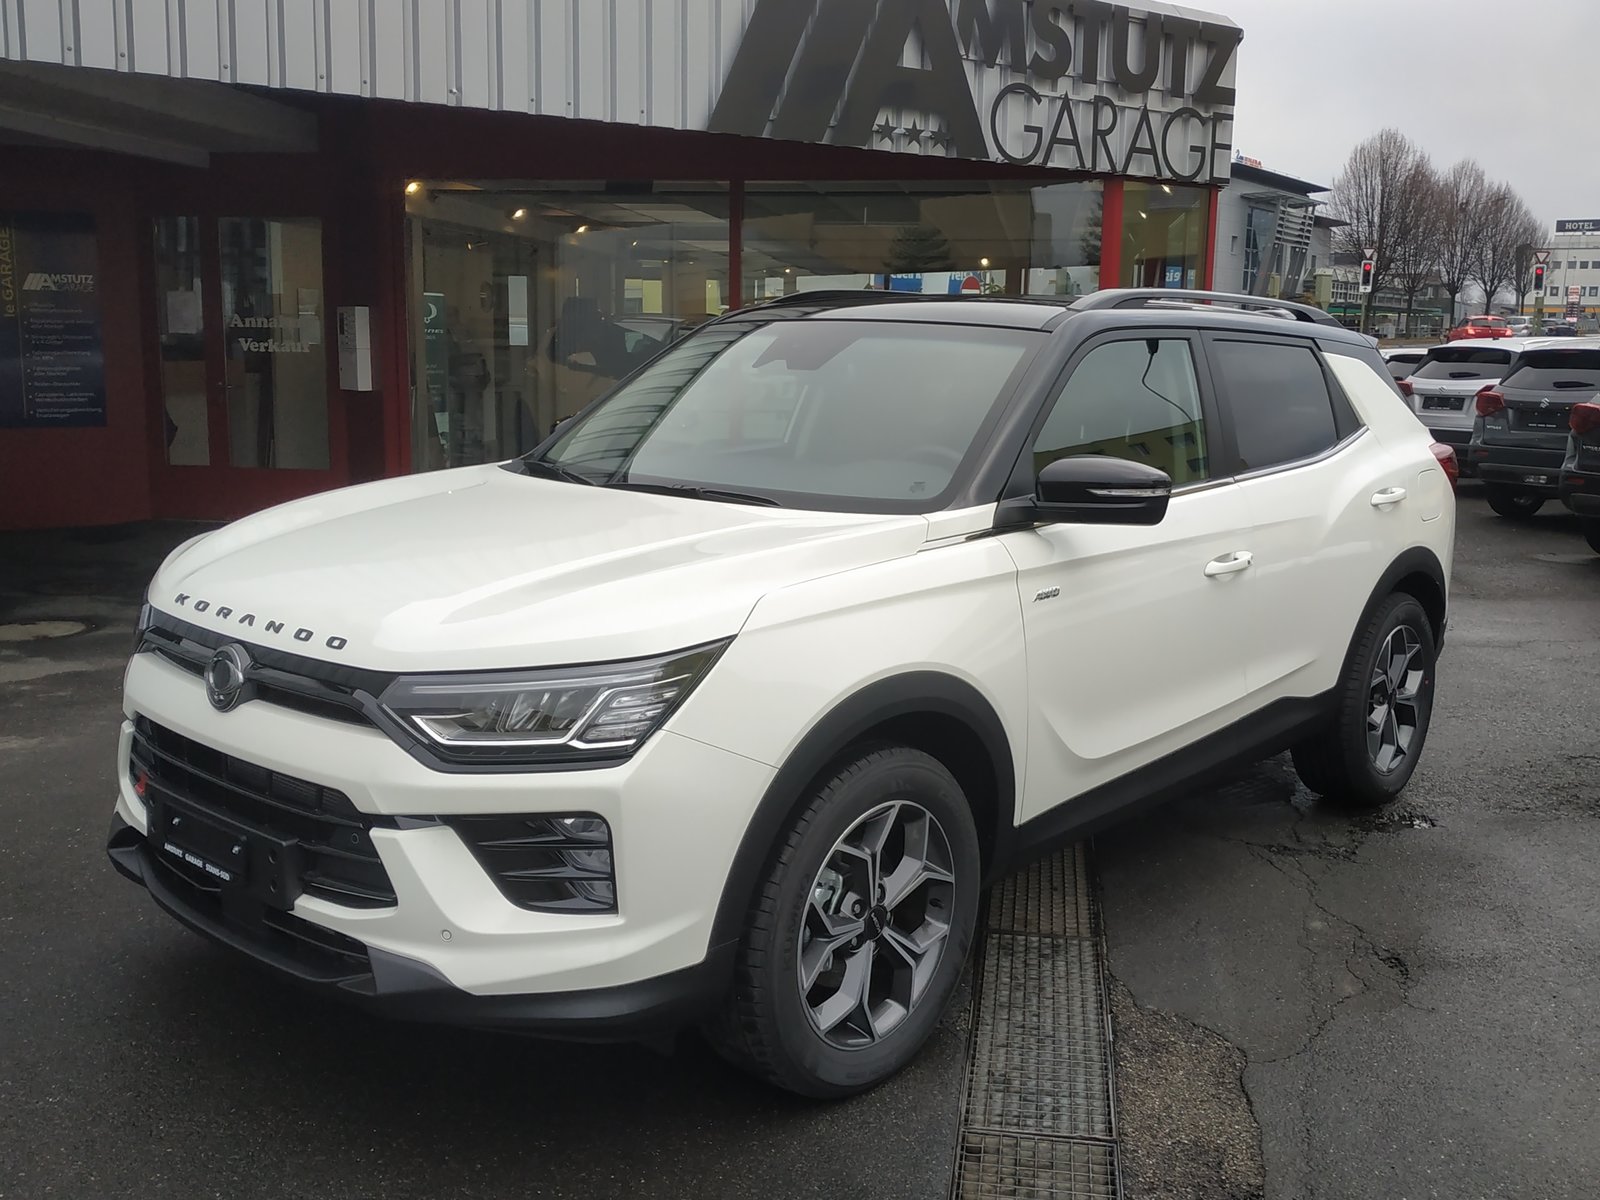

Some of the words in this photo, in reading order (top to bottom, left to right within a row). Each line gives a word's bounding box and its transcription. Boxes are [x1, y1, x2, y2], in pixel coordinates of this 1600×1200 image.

[990, 82, 1234, 184] GARAGE
[1565, 221, 1594, 231] HOTEL
[238, 337, 310, 353] Verkauf
[174, 593, 348, 650] KORANDO
